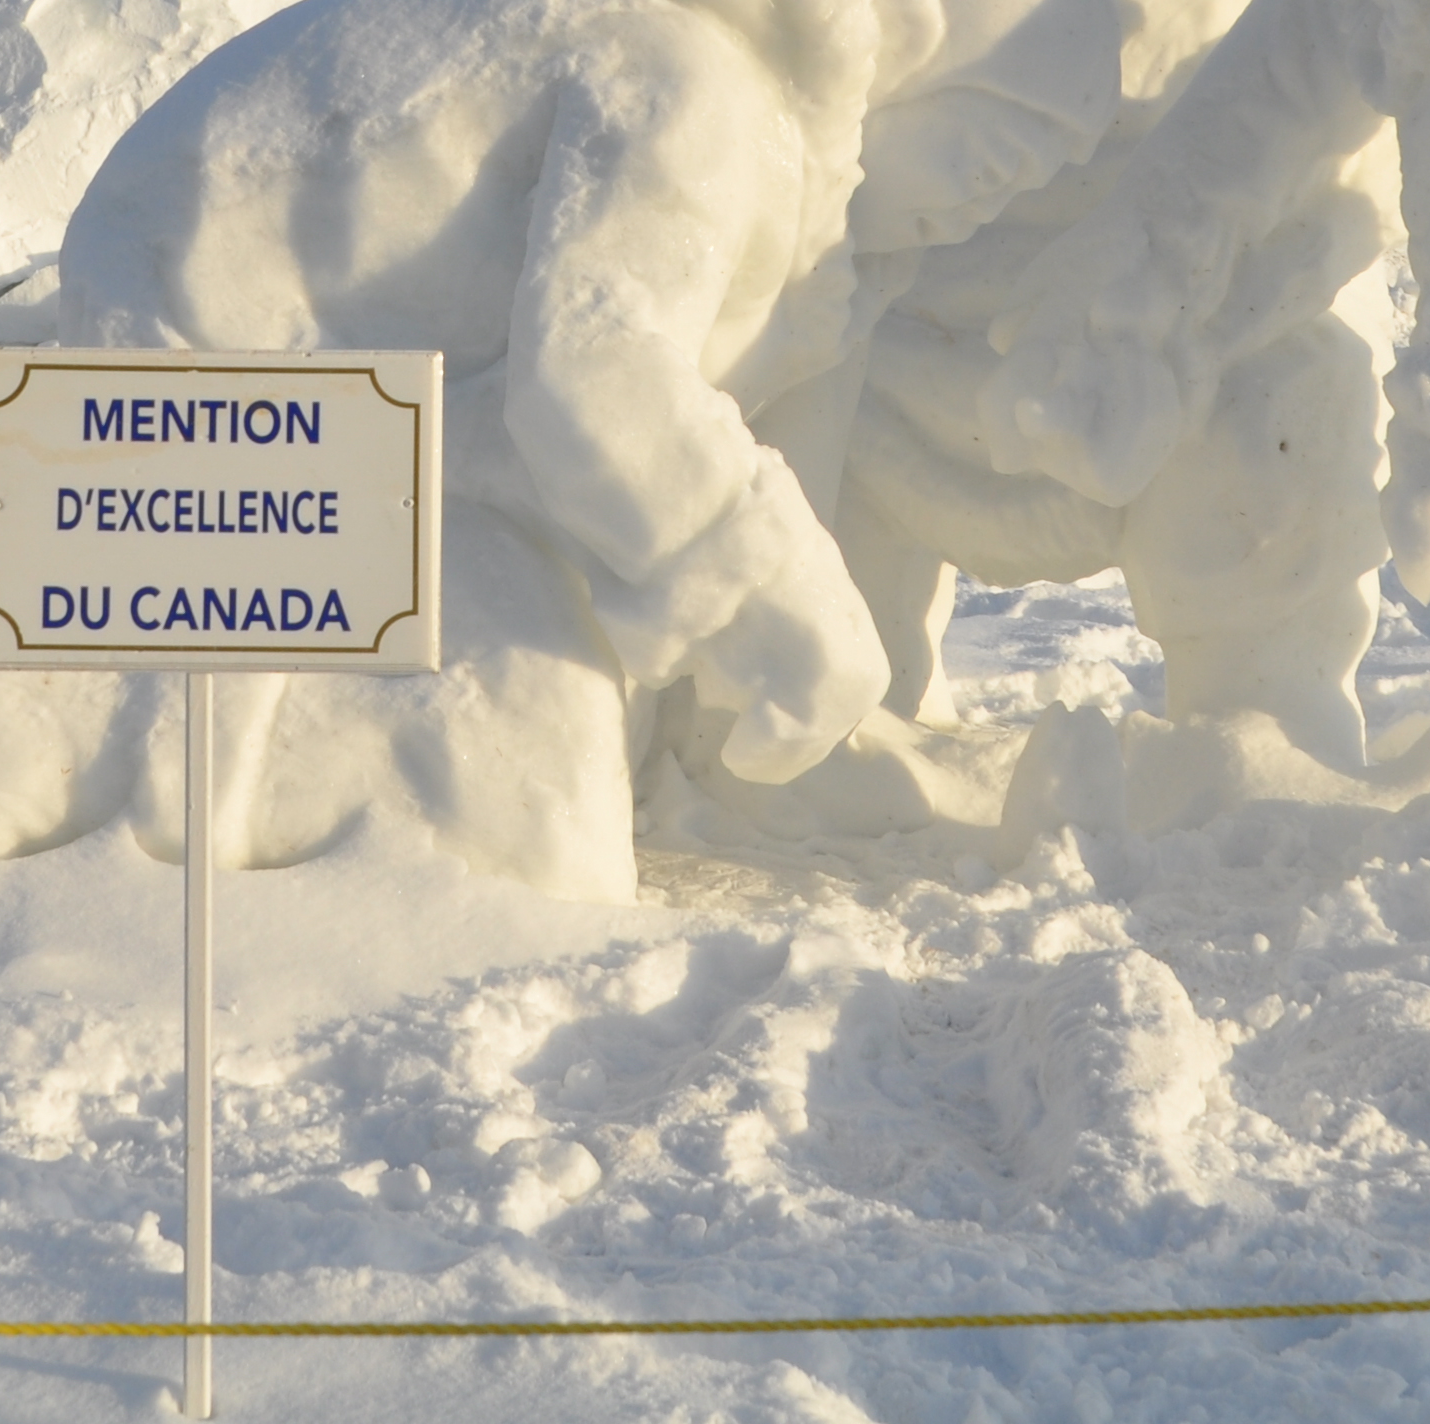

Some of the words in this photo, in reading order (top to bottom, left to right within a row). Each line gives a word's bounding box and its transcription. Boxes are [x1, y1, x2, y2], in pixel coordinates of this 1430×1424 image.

[83, 398, 320, 445] MENTION
[57, 487, 339, 535] D'EXCELLENCE
[41, 585, 111, 631] DU
[130, 586, 351, 632] CANADA
